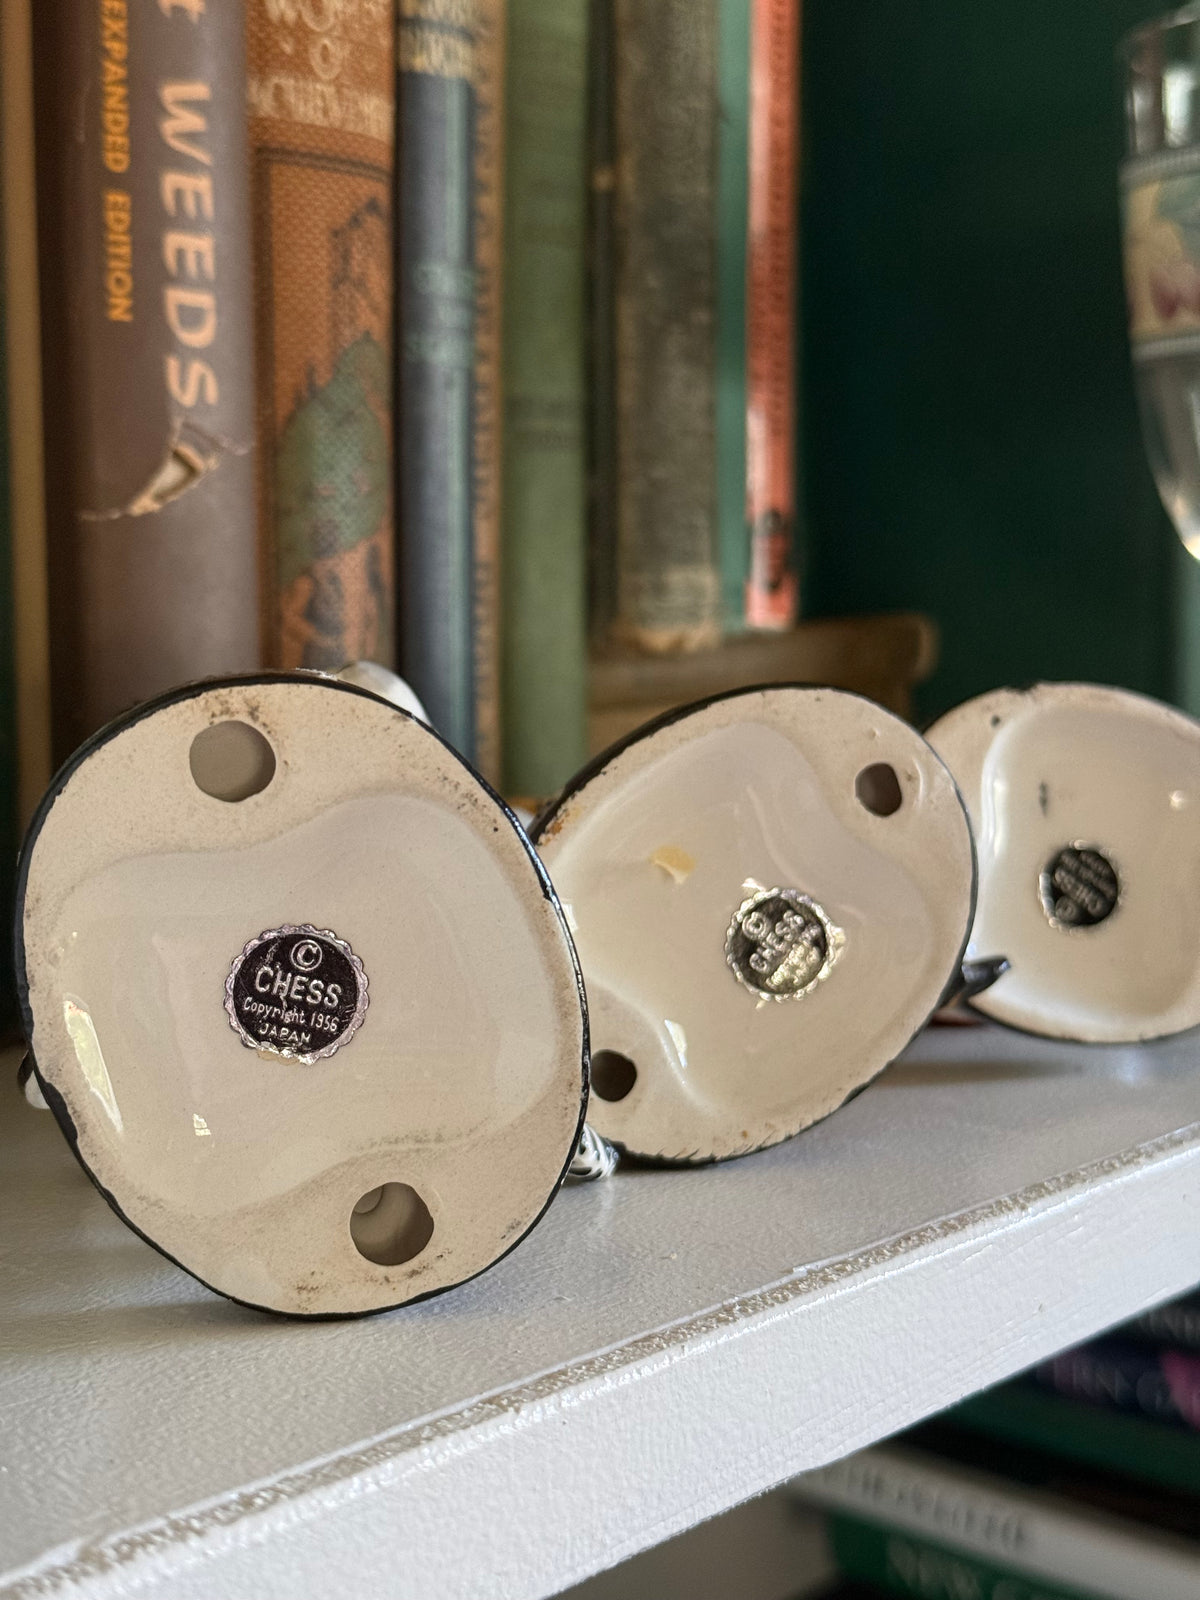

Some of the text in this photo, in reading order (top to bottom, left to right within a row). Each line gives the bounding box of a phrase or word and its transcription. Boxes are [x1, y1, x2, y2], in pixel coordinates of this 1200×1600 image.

[102, 0, 133, 322] EXPANDED EDITION
[160, 82, 218, 407] WEEDS
[255, 965, 342, 1008] CHESS
[243, 997, 340, 1032] Copyright 1956
[259, 1023, 311, 1044] JAPAN
